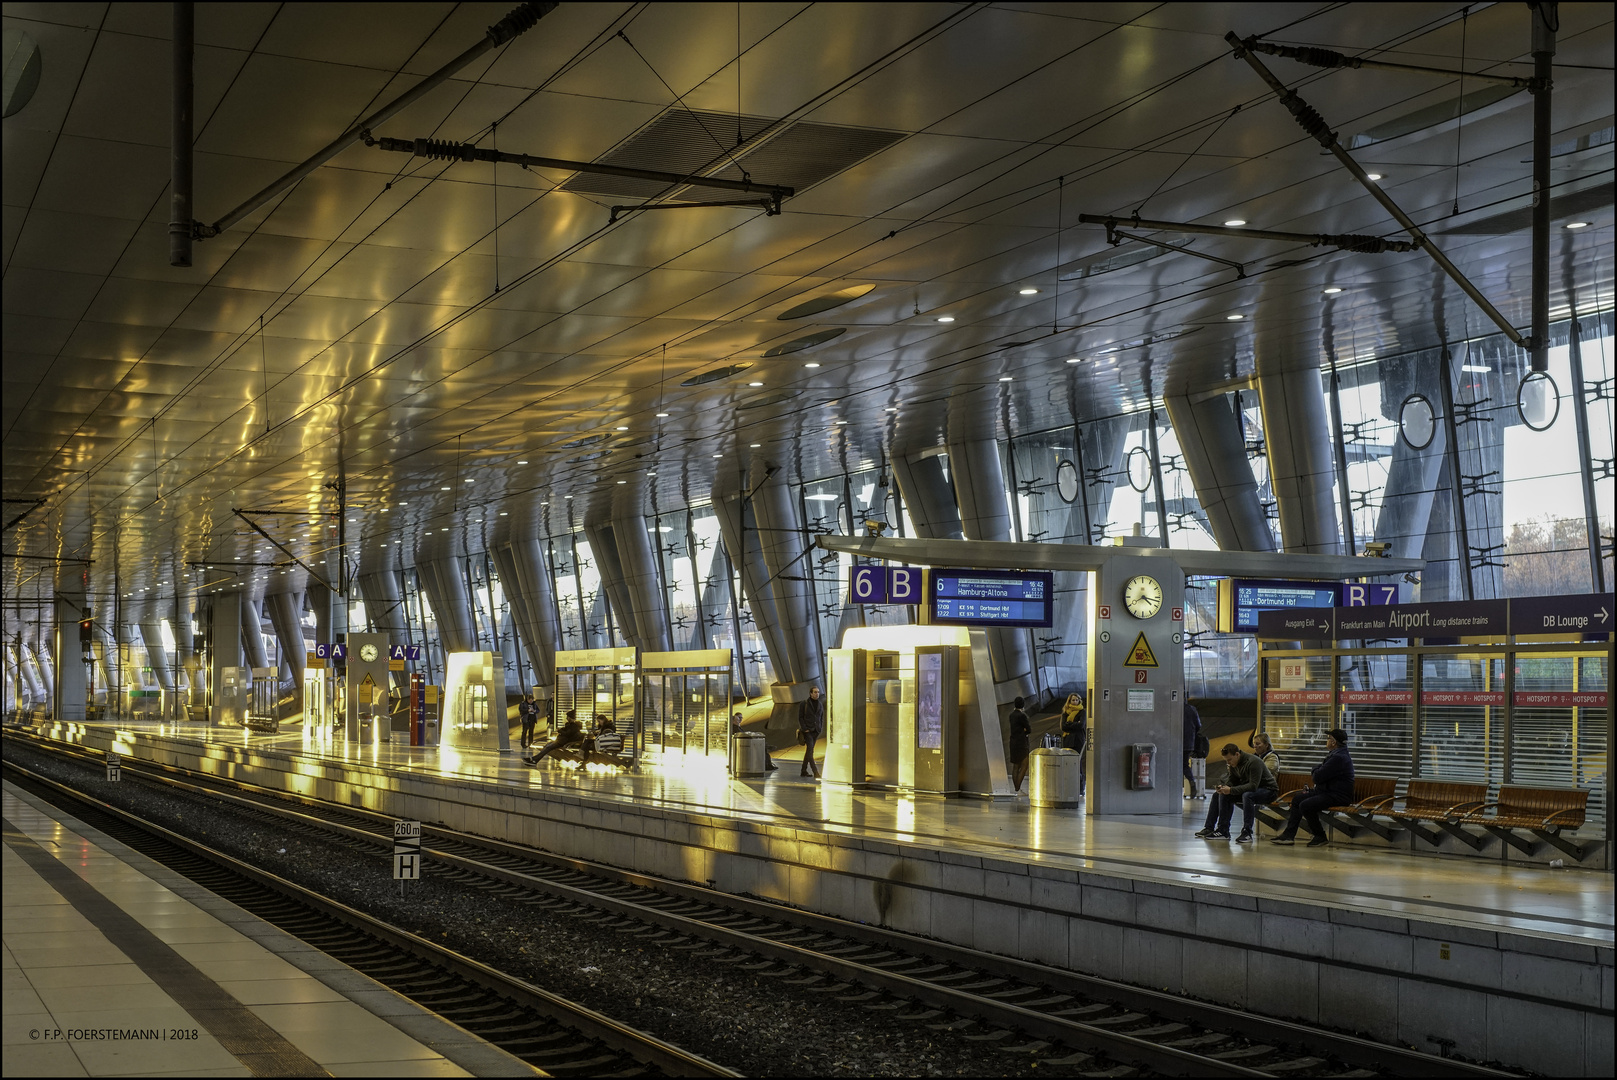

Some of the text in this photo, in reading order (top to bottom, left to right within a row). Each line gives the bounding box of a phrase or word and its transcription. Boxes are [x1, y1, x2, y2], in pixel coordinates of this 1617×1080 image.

[856, 569, 872, 597] 6
[892, 570, 911, 598] B
[937, 578, 944, 591] 6
[958, 588, 1008, 597] Hamburg-Altona
[1327, 591, 1334, 603] 7
[1382, 587, 1395, 605] 7
[1285, 620, 1305, 628] Ausgang
[1341, 621, 1363, 630] Frankfurt
[1389, 610, 1430, 631] Airport
[1433, 618, 1446, 628] Long
[1448, 617, 1471, 625] distance
[1472, 616, 1488, 624] trains
[1543, 615, 1588, 628] DB Lounge
[317, 645, 325, 656] 6
[332, 645, 342, 656] A
[394, 646, 404, 657] A
[411, 647, 418, 658] 7
[1104, 690, 1109, 699] F
[1172, 691, 1177, 700] F
[110, 770, 117, 780] H
[396, 823, 411, 835] 260
[400, 856, 414, 878] H
